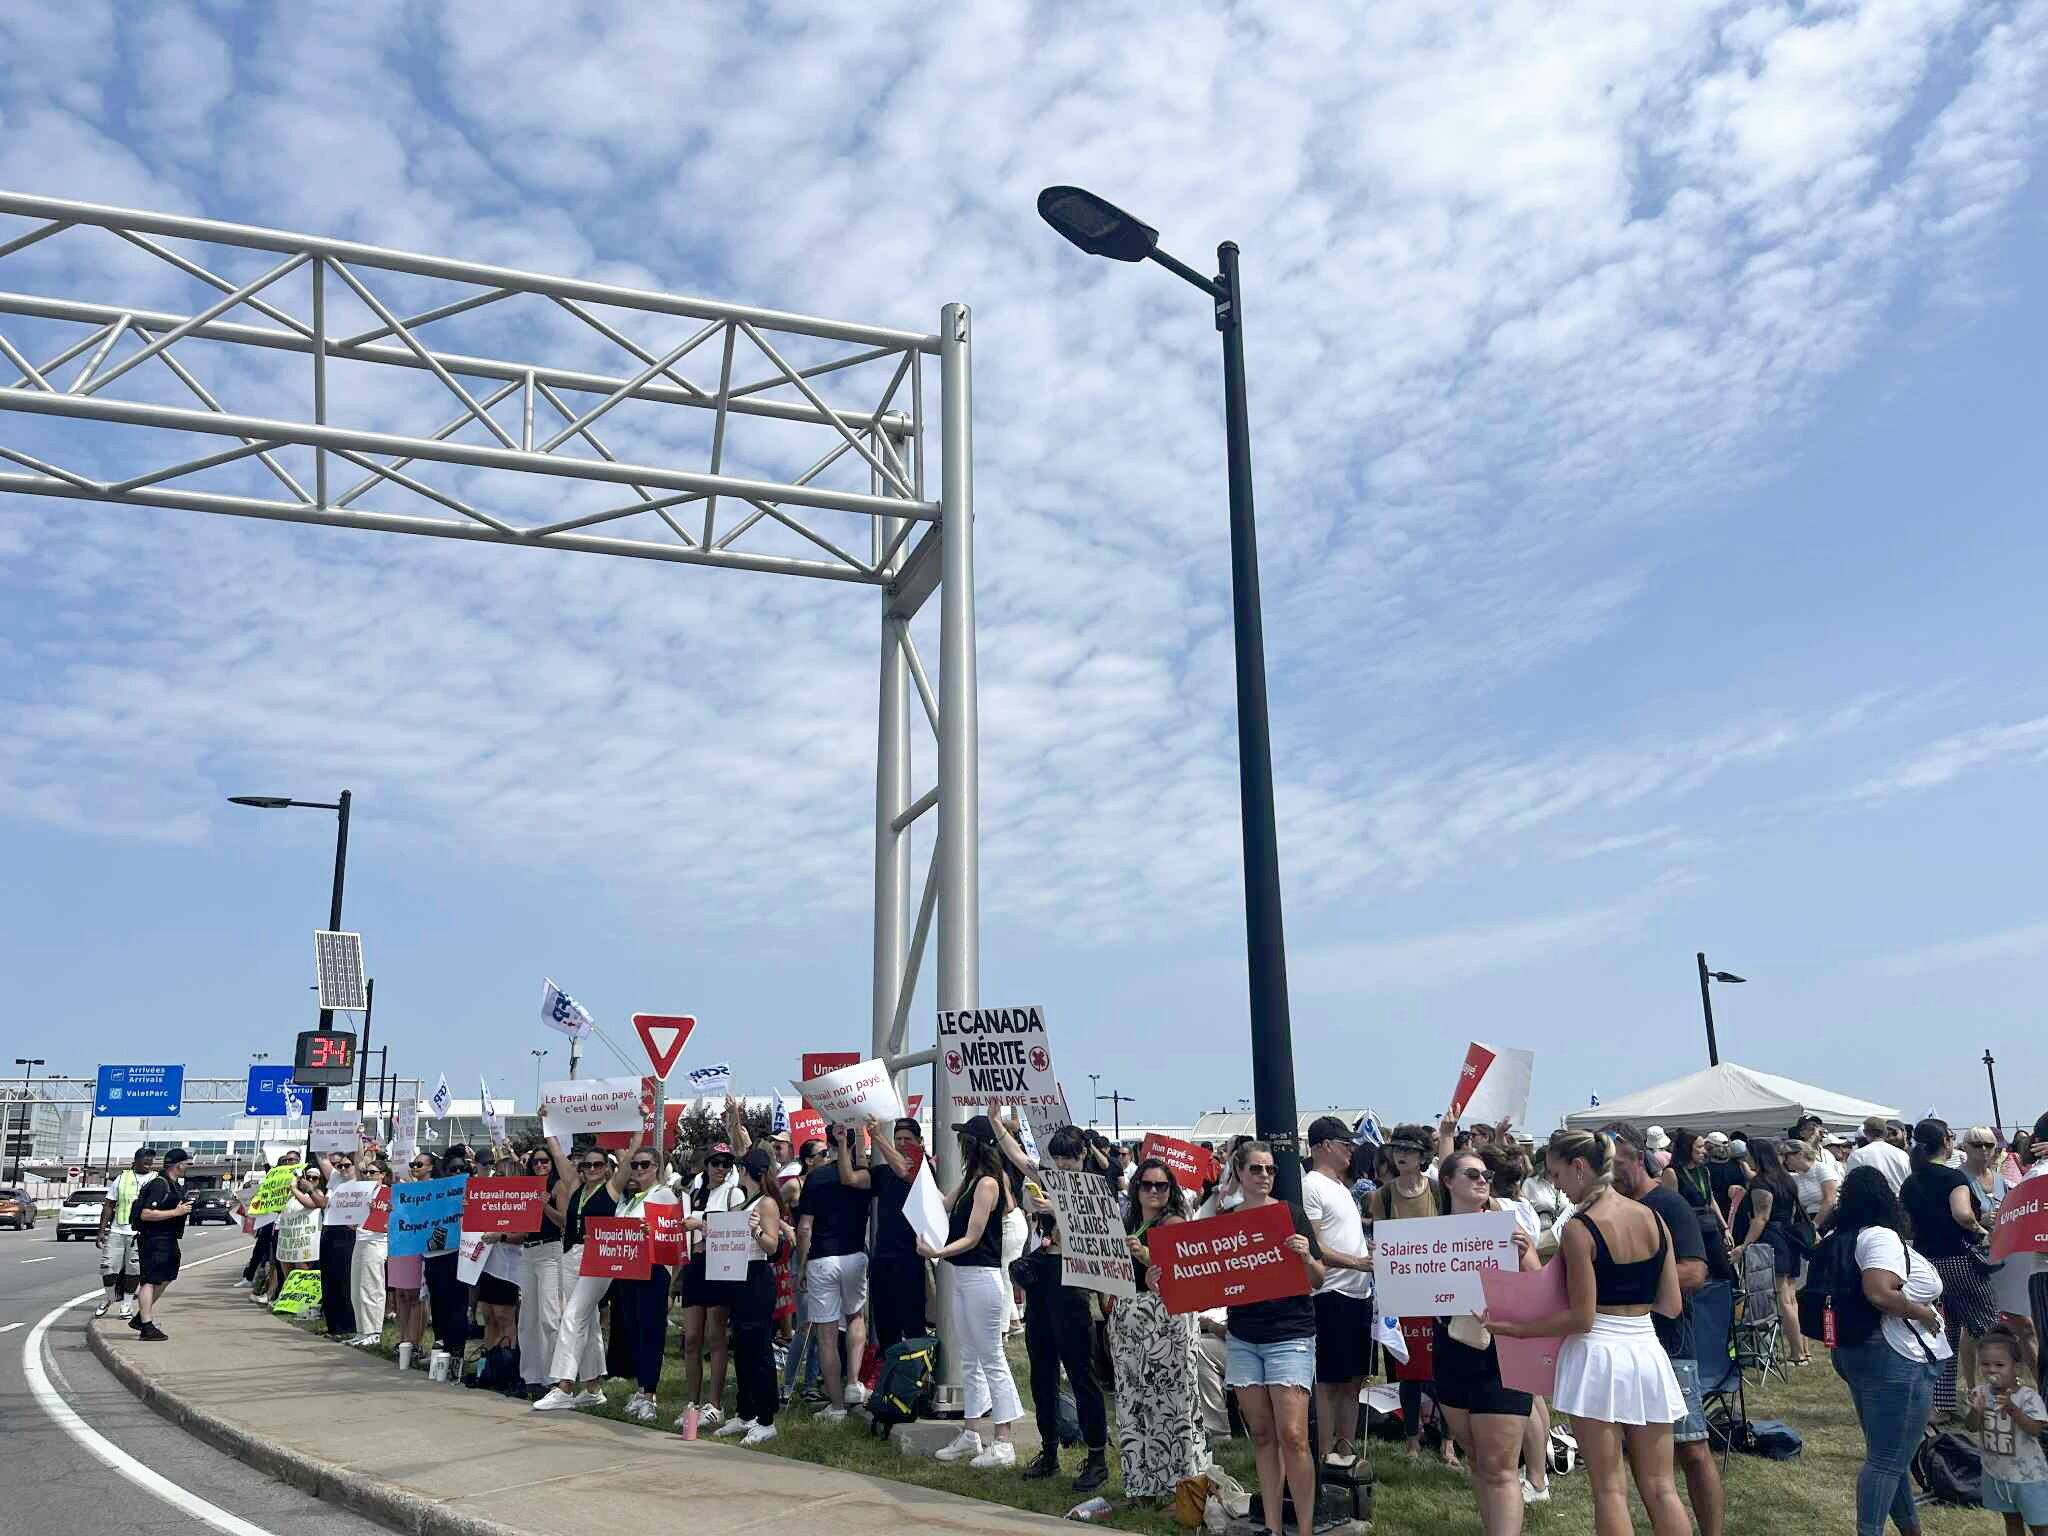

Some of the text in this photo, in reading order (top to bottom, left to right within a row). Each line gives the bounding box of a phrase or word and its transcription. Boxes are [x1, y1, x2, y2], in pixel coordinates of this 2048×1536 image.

[937, 1008, 1044, 1035] LE CANADA
[311, 1037, 346, 1068] 34
[961, 1035, 1026, 1066] MÉRITE
[968, 1068, 1029, 1092] MIEUX
[545, 1096, 557, 1104] Le
[559, 1092, 588, 1104] travail
[591, 1092, 609, 1101] non
[834, 1084, 853, 1097] non
[565, 1104, 588, 1113] c'est
[590, 1104, 602, 1112] du
[1040, 1095, 1059, 1106] VOL
[1167, 1158, 1198, 1174] respect
[469, 1190, 479, 1200] Le
[480, 1190, 504, 1200] travail
[505, 1191, 520, 1200] non
[481, 1201, 500, 1212] c'est
[501, 1201, 513, 1212] du
[594, 1227, 623, 1244] Unpaid
[654, 1229, 684, 1242] Aucun
[599, 1243, 638, 1260] Won't Fly!
[1175, 1229, 1265, 1259] Non payé =
[1380, 1236, 1508, 1257] Salaires de misère =
[1173, 1245, 1285, 1280] Aucun respect
[1390, 1255, 1499, 1275] Pas notre Canada
[1223, 1283, 1246, 1297] SCFP
[1433, 1292, 1456, 1304] SCFP
[1404, 1325, 1419, 1337] Le
